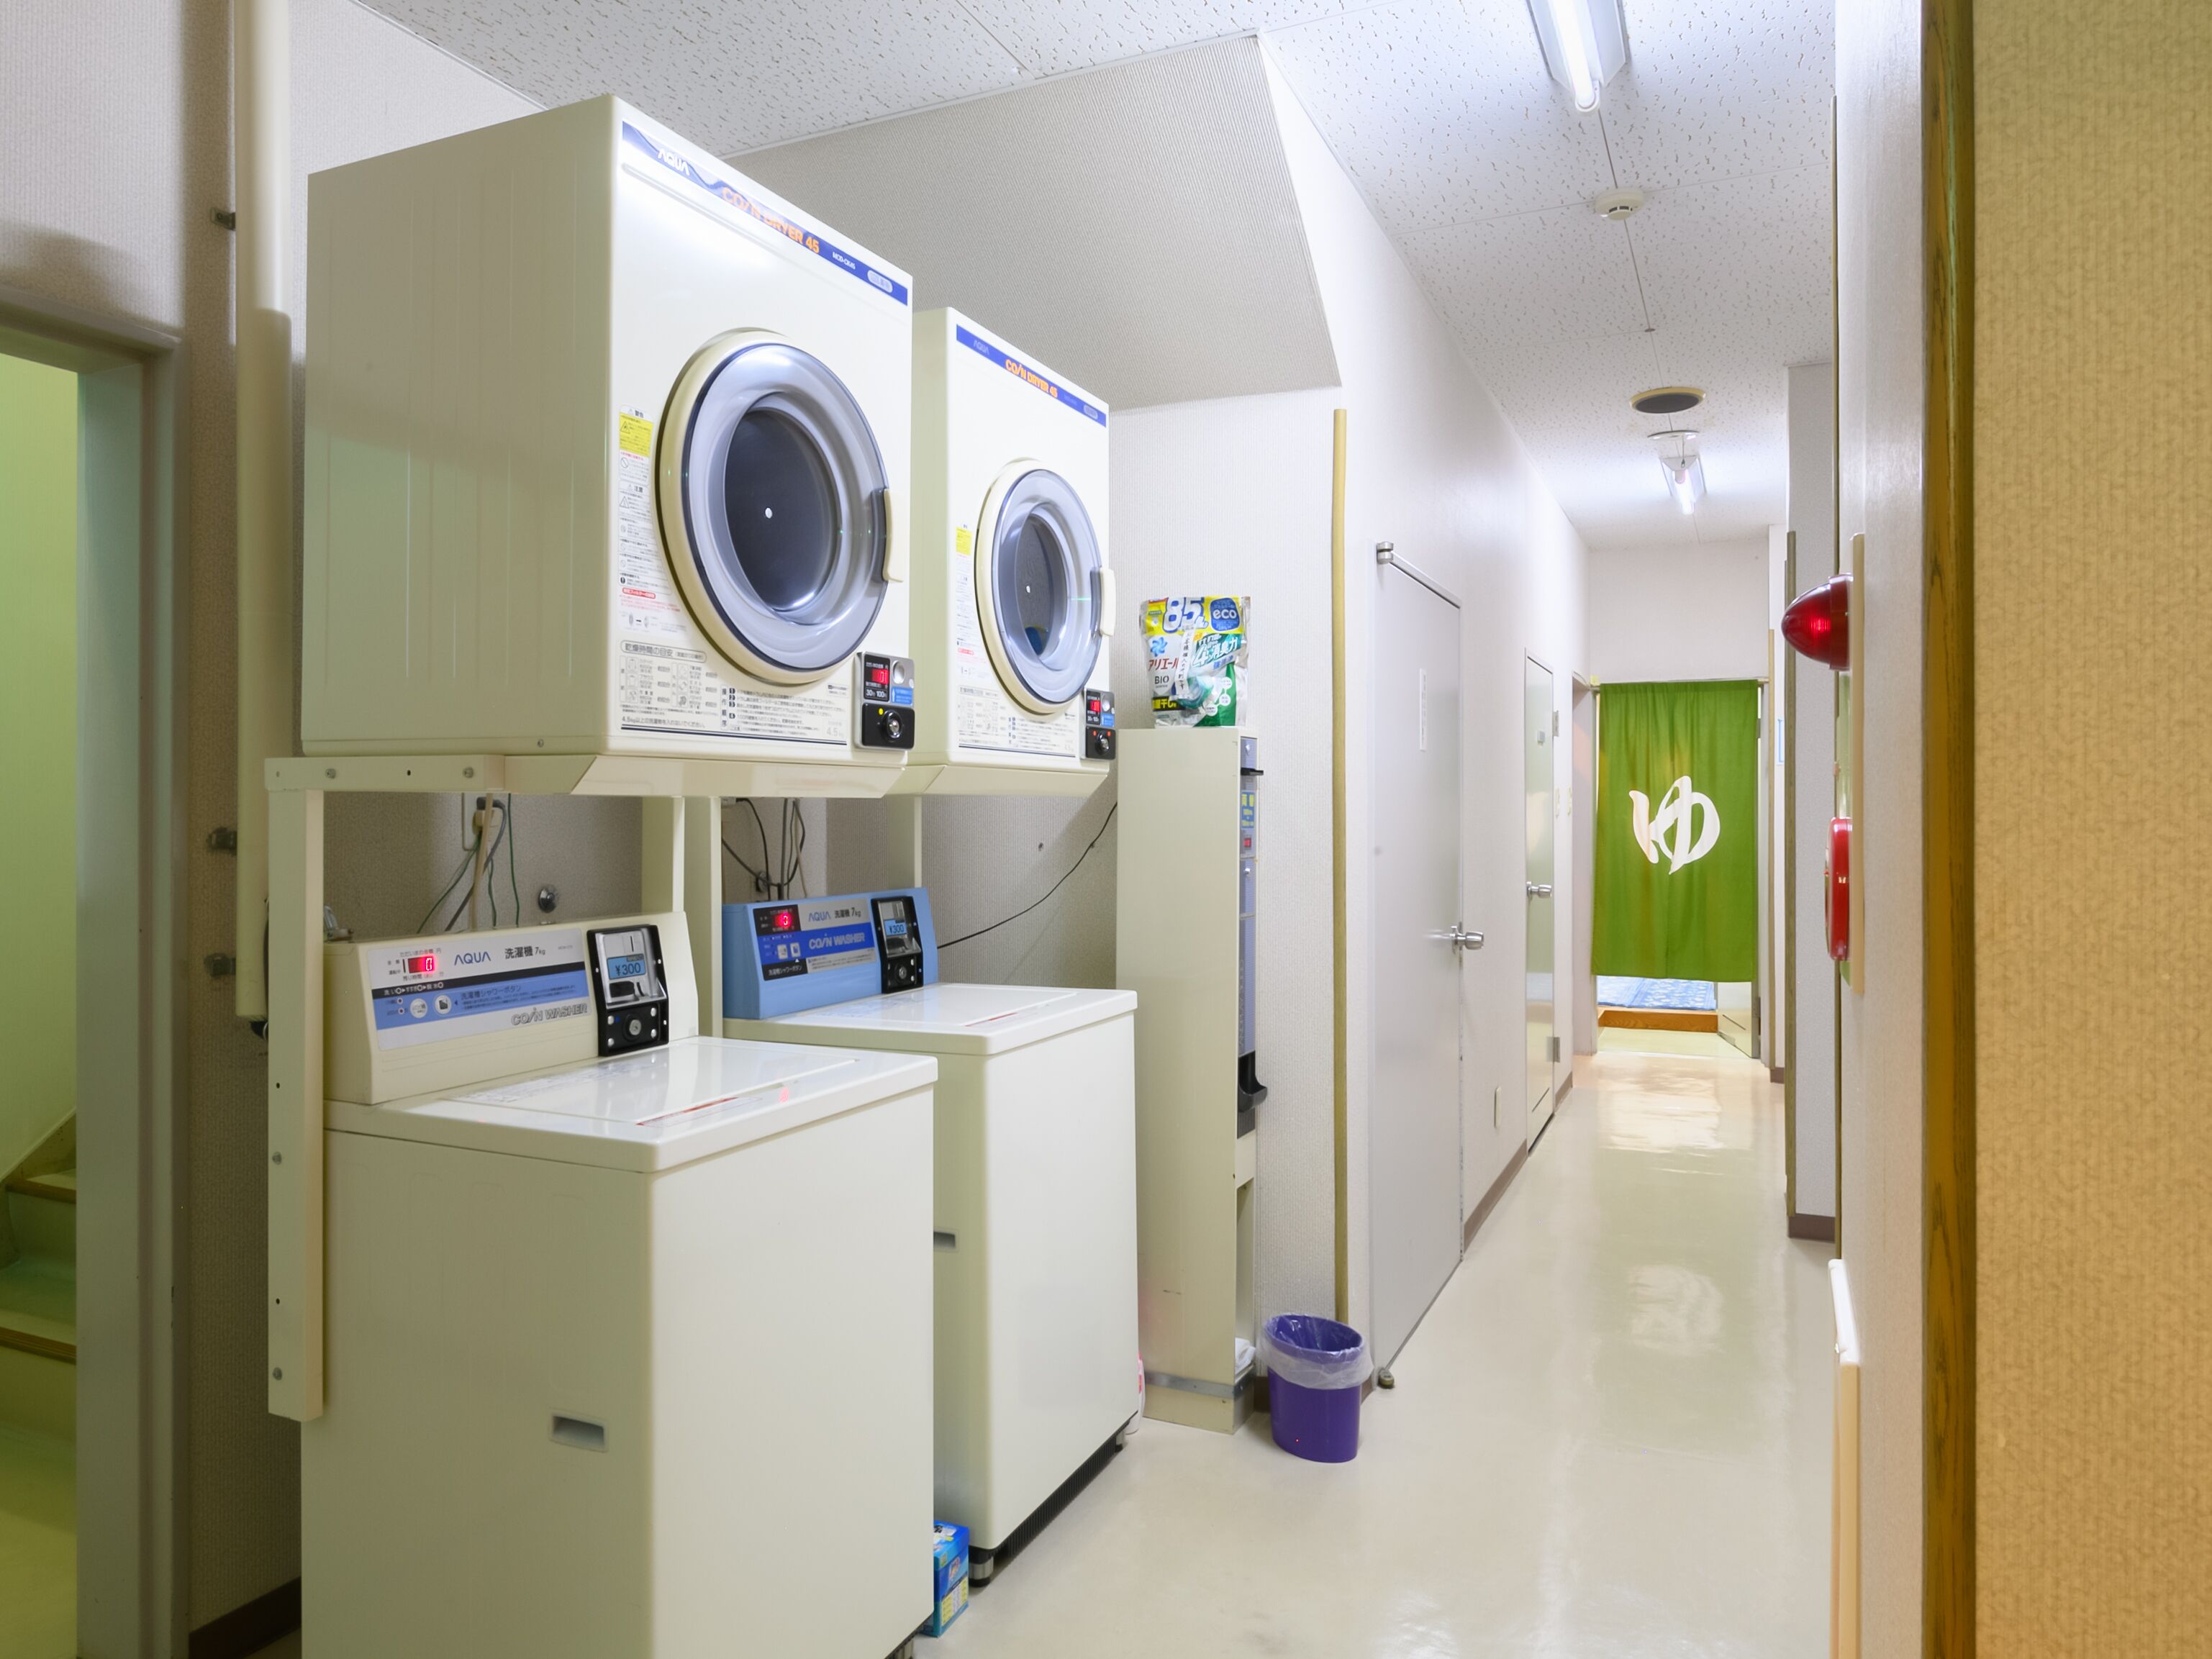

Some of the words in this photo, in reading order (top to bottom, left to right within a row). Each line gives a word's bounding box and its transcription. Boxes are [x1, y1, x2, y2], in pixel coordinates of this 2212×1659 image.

[657, 149, 690, 176] AQUA
[805, 236, 820, 254] 45
[1212, 609, 1237, 619] eco
[1148, 657, 1179, 671] アリエール
[1154, 675, 1169, 684] BIO
[1628, 775, 1721, 875] ゆ
[808, 911, 831, 922] AQUA
[889, 923, 905, 934] ¥300
[833, 932, 865, 946] WASHER
[454, 951, 491, 966] AQUA
[504, 946, 533, 960] 洗濯機
[535, 946, 546, 955] 7kg
[615, 963, 641, 976] ¥300
[545, 1003, 588, 1020] WASHER
